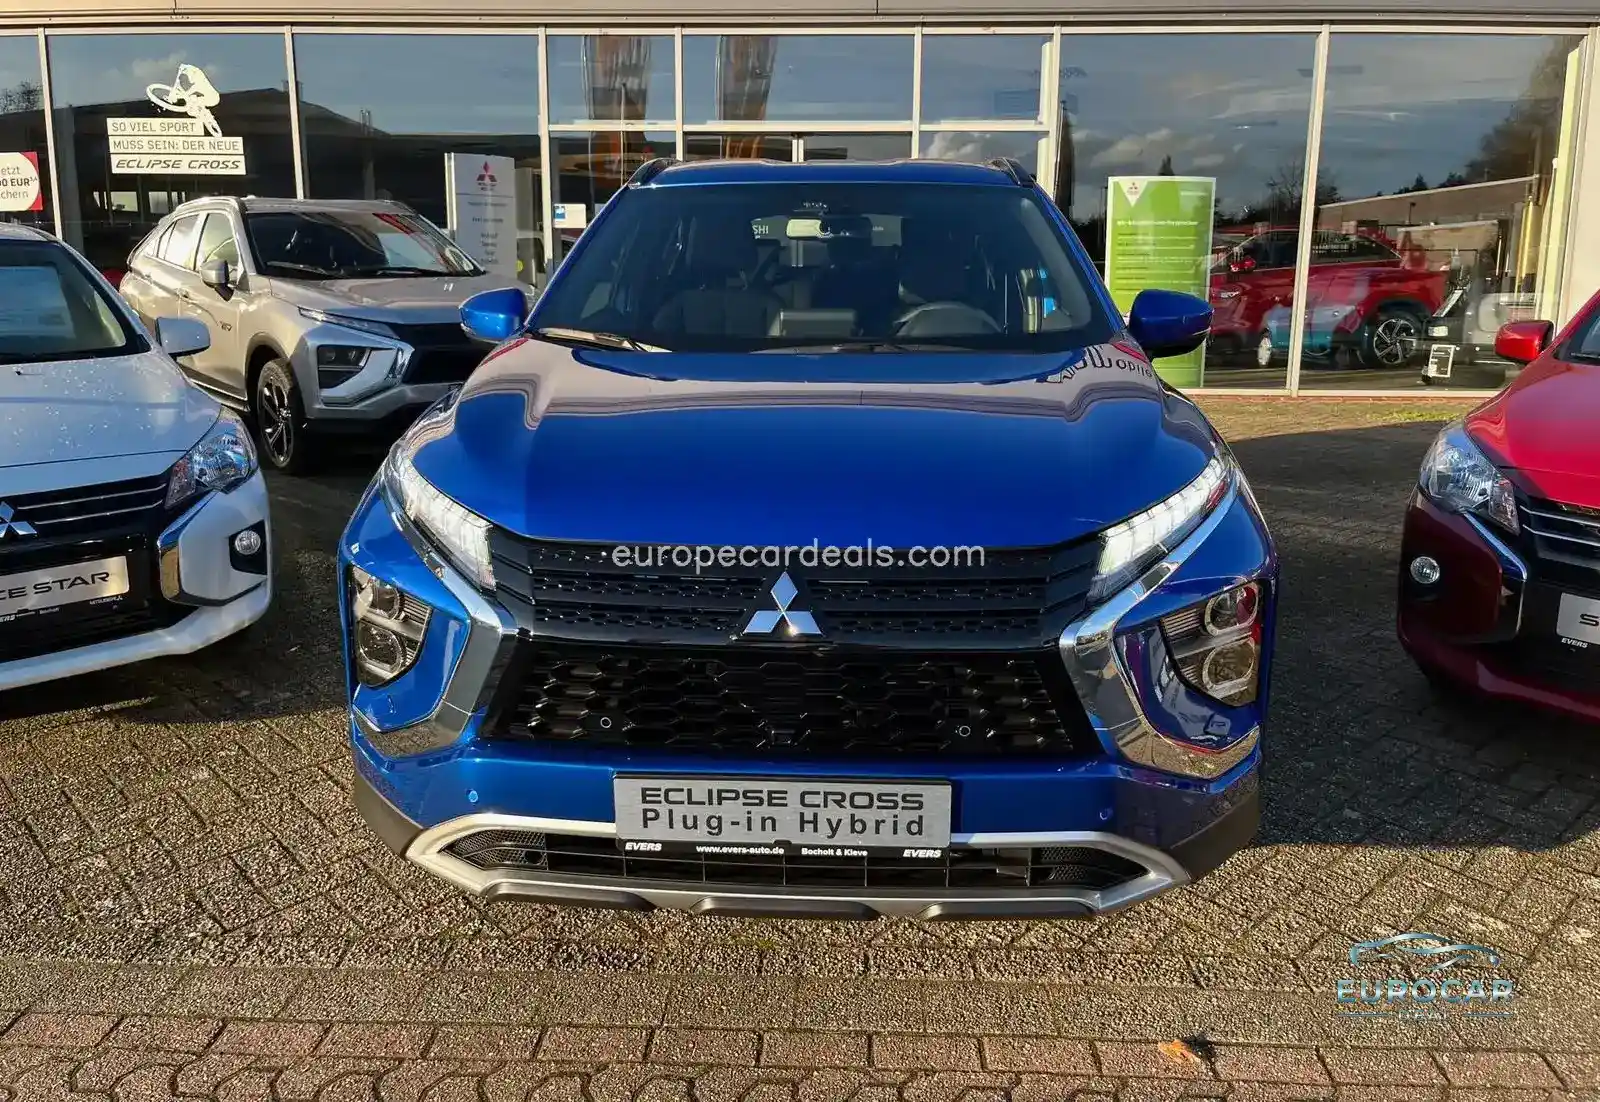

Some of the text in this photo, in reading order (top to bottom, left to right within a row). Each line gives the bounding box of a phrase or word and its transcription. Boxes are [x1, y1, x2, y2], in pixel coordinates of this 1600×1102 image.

[111, 121, 196, 132] SO VIEL SPORT
[113, 139, 239, 151] MUSS SEIN: DER NEUE
[115, 158, 241, 170] ECLIPSE CROSS
[0, 178, 8, 187] 0
[33, 571, 110, 595] STAR
[1561, 637, 1588, 648] EVERS
[640, 787, 924, 811] ECLIPSE CROSS
[642, 807, 924, 840] Plug-in Hybrid
[625, 841, 662, 852] EVERS
[696, 845, 785, 855] www.evers-auto.de
[801, 847, 869, 857] Bocholt & Kleve
[902, 848, 942, 859] EVERS
